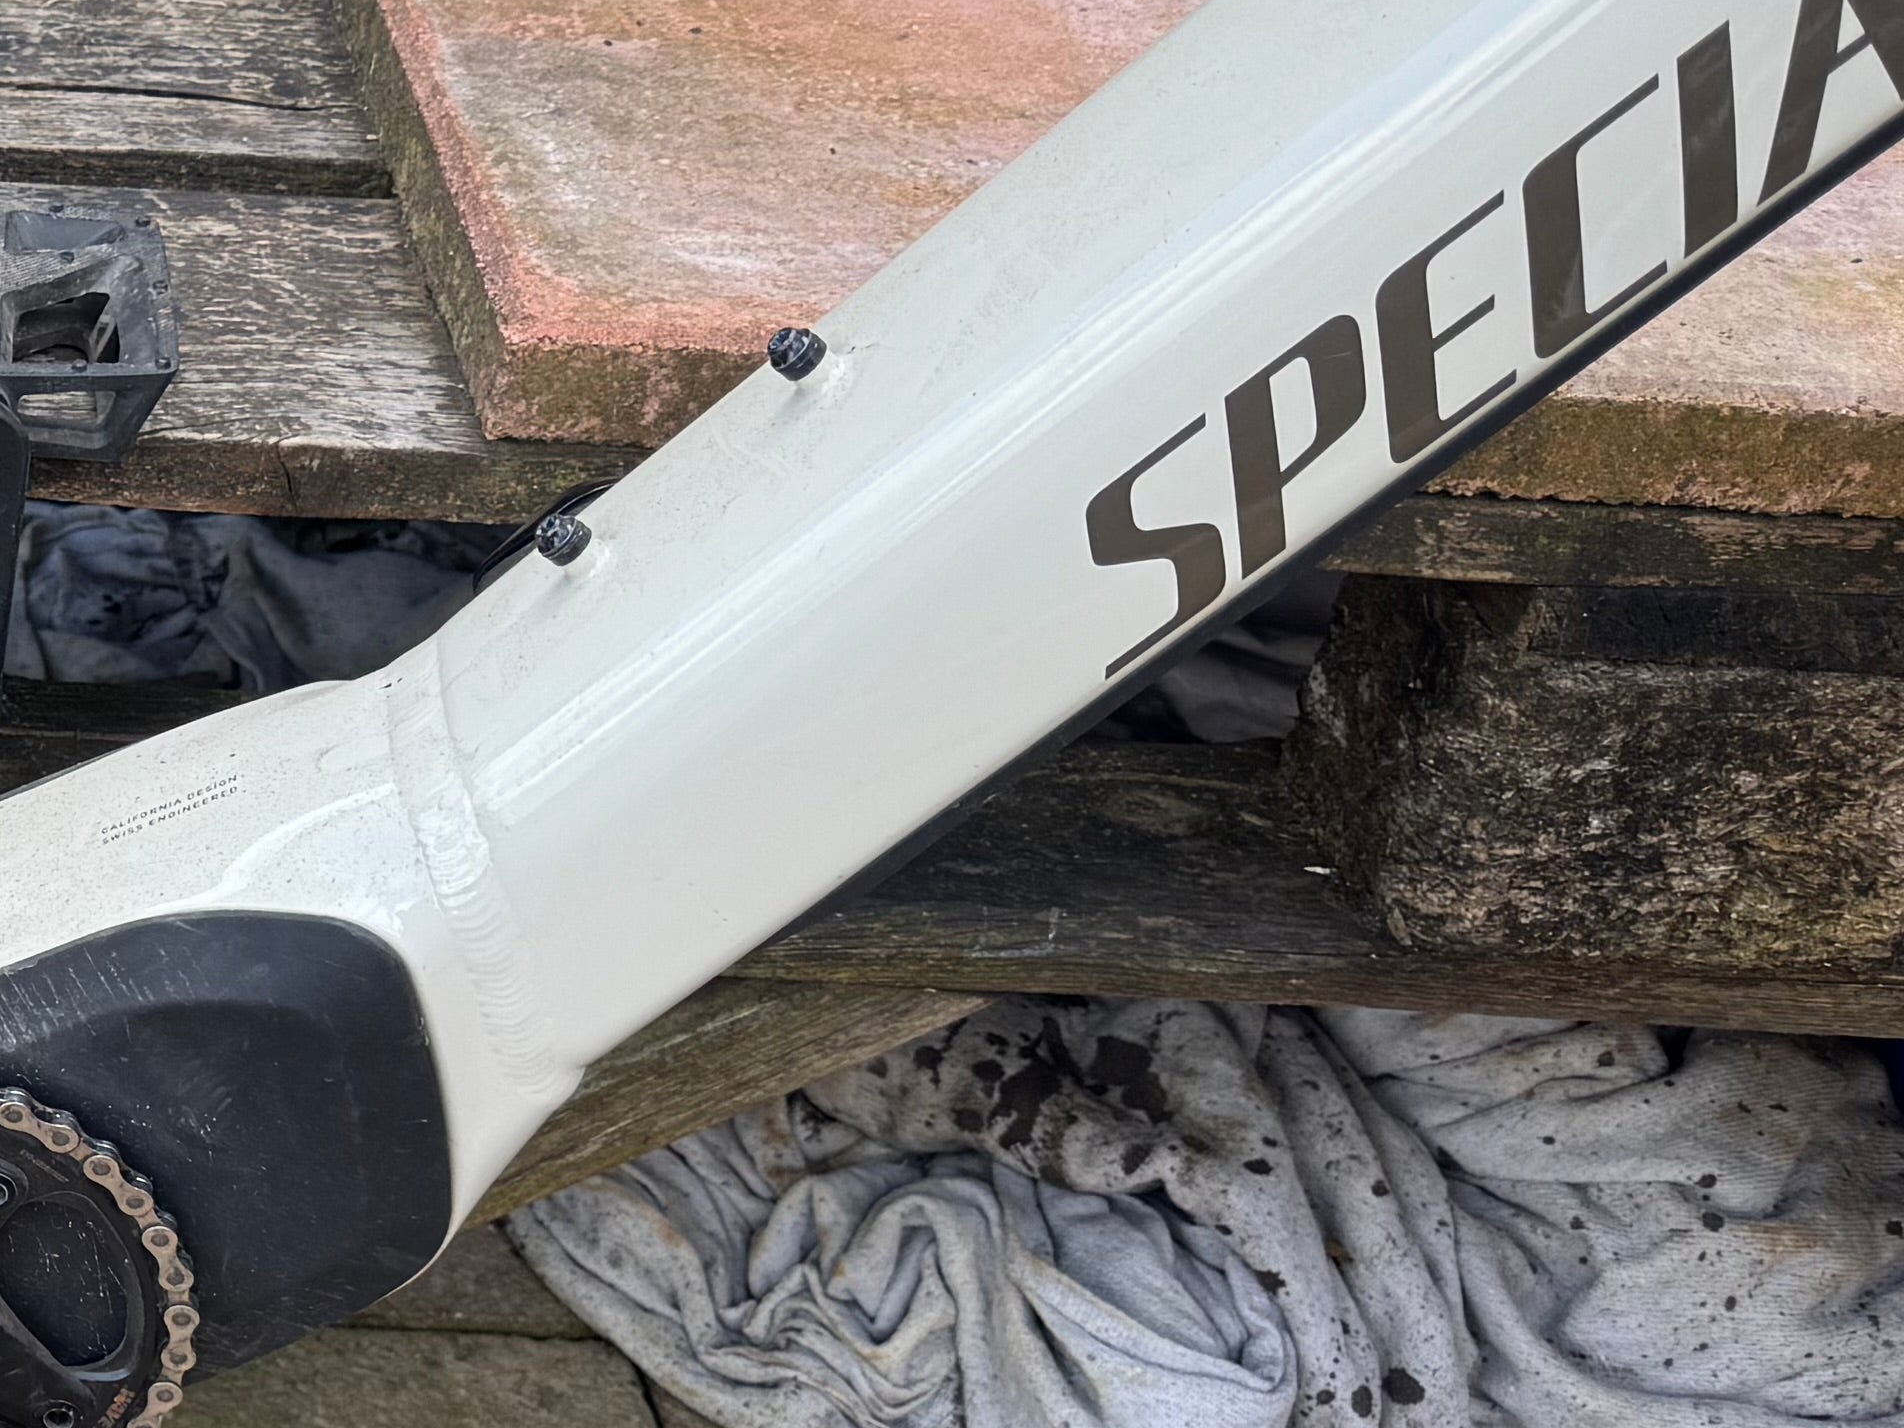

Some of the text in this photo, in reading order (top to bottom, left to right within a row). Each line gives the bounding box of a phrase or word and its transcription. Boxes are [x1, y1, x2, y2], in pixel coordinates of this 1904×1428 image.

[100, 774, 238, 835] CALIFORNIA DESIGN
[102, 785, 238, 845] SWISS ENGINEERED
